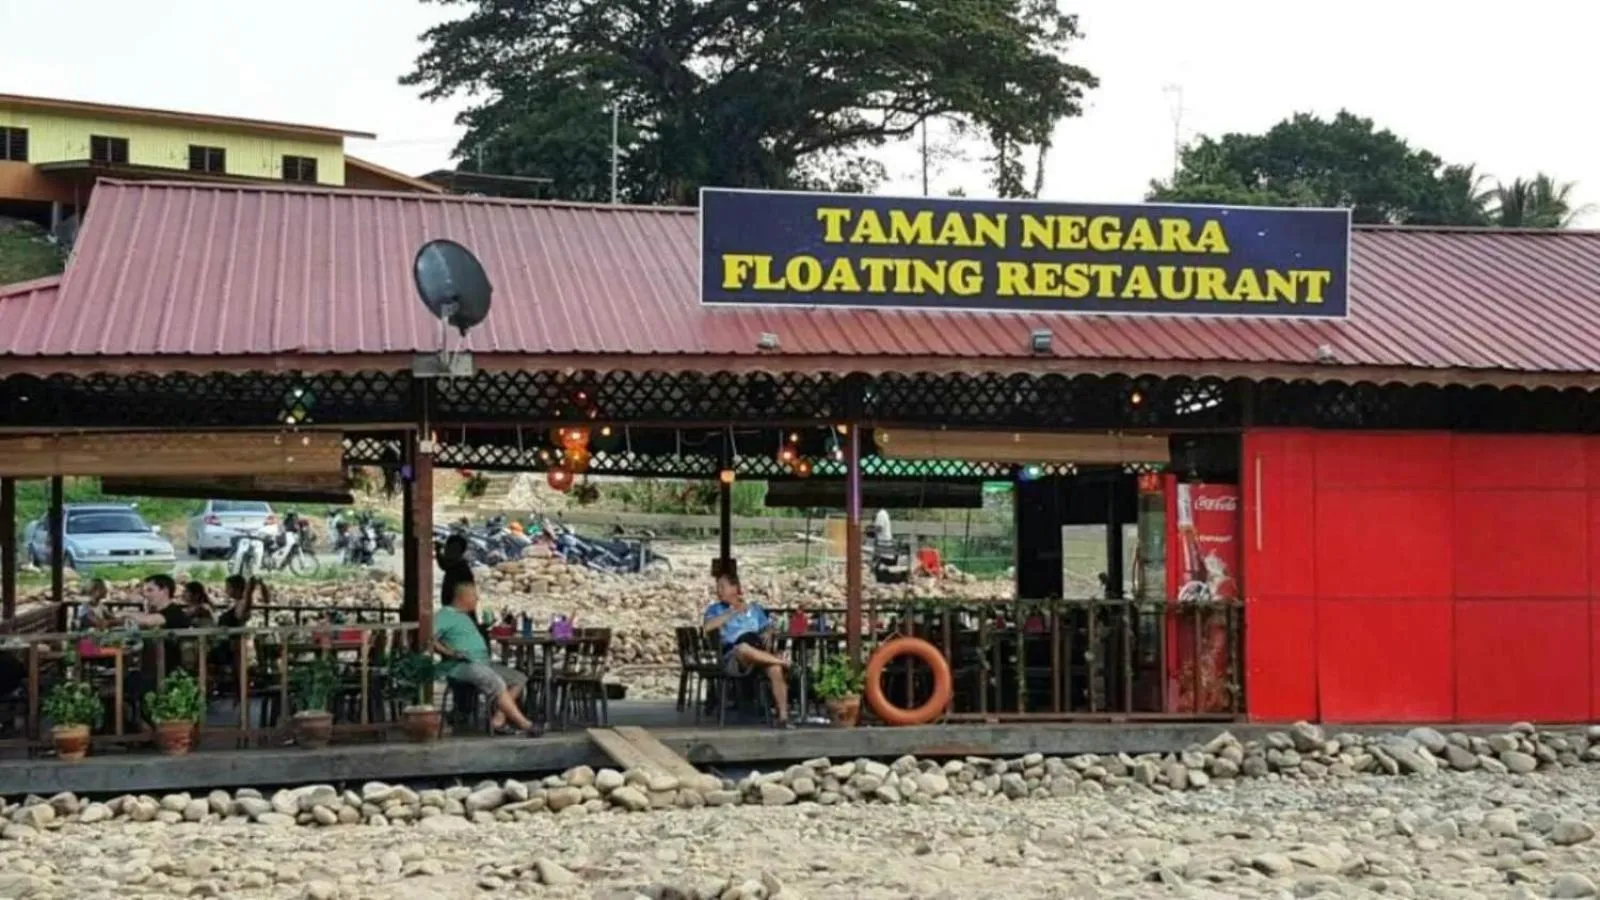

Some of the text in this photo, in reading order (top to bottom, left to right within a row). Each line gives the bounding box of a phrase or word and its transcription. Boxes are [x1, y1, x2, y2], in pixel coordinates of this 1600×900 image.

[817, 207, 1229, 254] TAMAN NEGARA
[722, 254, 1331, 304] FLOATING RESTAURANT
